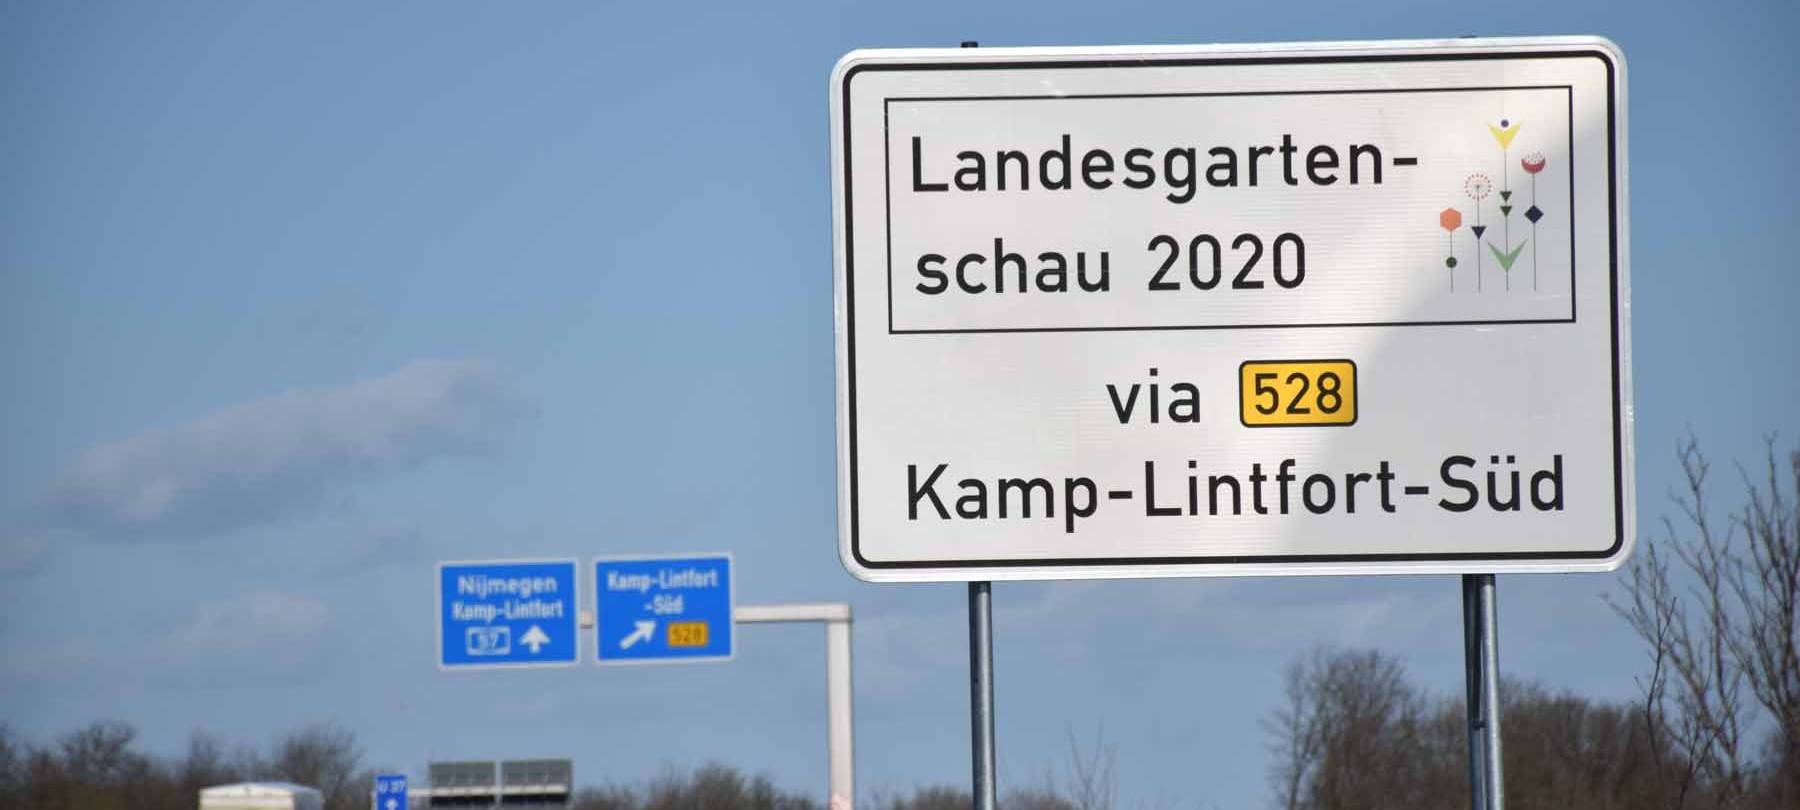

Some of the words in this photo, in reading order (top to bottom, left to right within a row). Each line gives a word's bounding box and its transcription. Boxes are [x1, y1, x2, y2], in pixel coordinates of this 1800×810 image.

[911, 134, 1420, 204] Landesgarten-
[915, 237, 1111, 295] schau
[1148, 233, 1308, 291] 2020
[1106, 368, 1202, 425] via
[1255, 371, 1343, 416] 528
[907, 454, 1566, 534] Kamp-Lintfort-Süd
[457, 574, 558, 598] Nijmegen
[607, 568, 718, 593] Kamp-Lintfort
[452, 599, 564, 623] Kamp-Lintfort
[644, 594, 684, 615] -Süd
[670, 625, 703, 641] 528
